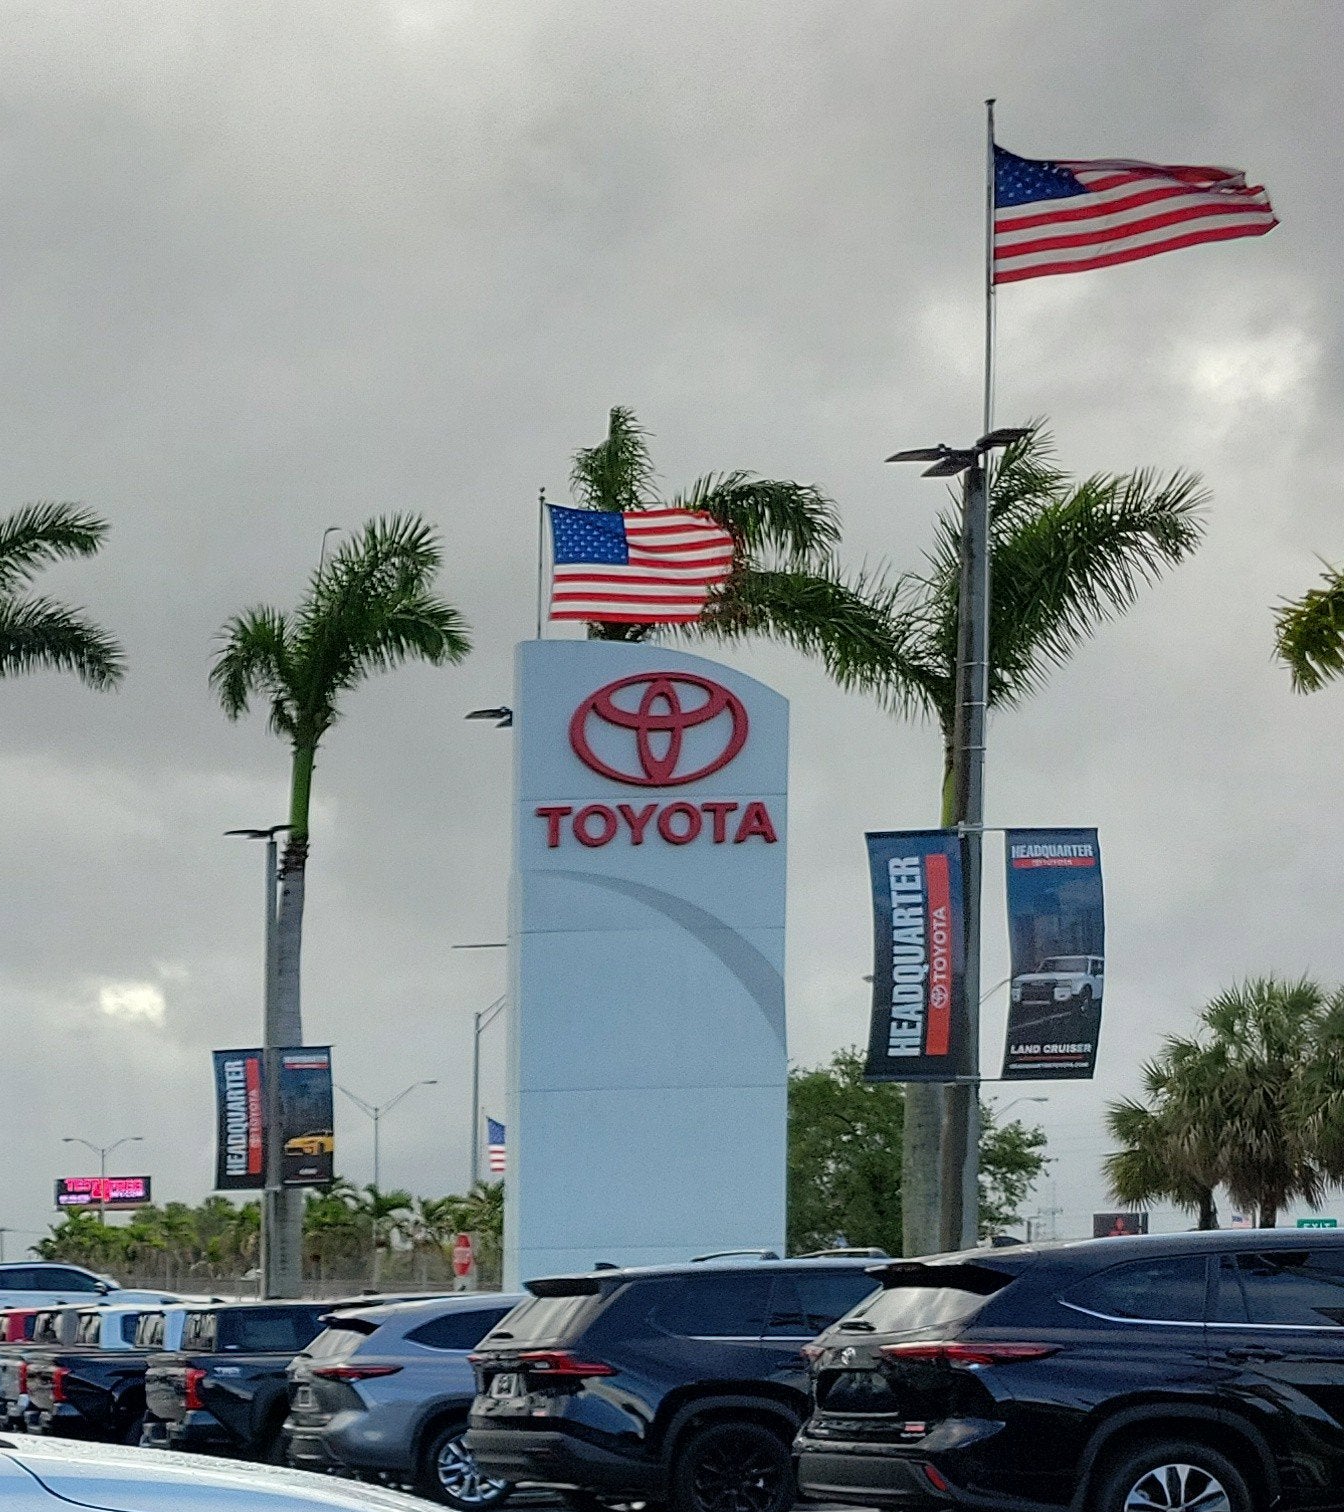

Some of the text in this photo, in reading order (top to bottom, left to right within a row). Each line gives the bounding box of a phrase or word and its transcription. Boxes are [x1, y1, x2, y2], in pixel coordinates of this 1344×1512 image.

[535, 801, 779, 848] TOYOTA
[1011, 844, 1093, 859] HEADQUARTER
[887, 855, 929, 1058] HEADQUARTER
[932, 905, 947, 984] TOYOTA
[1011, 1042, 1092, 1055] LAND CRUISER
[224, 1060, 248, 1176] HEADQUARTER
